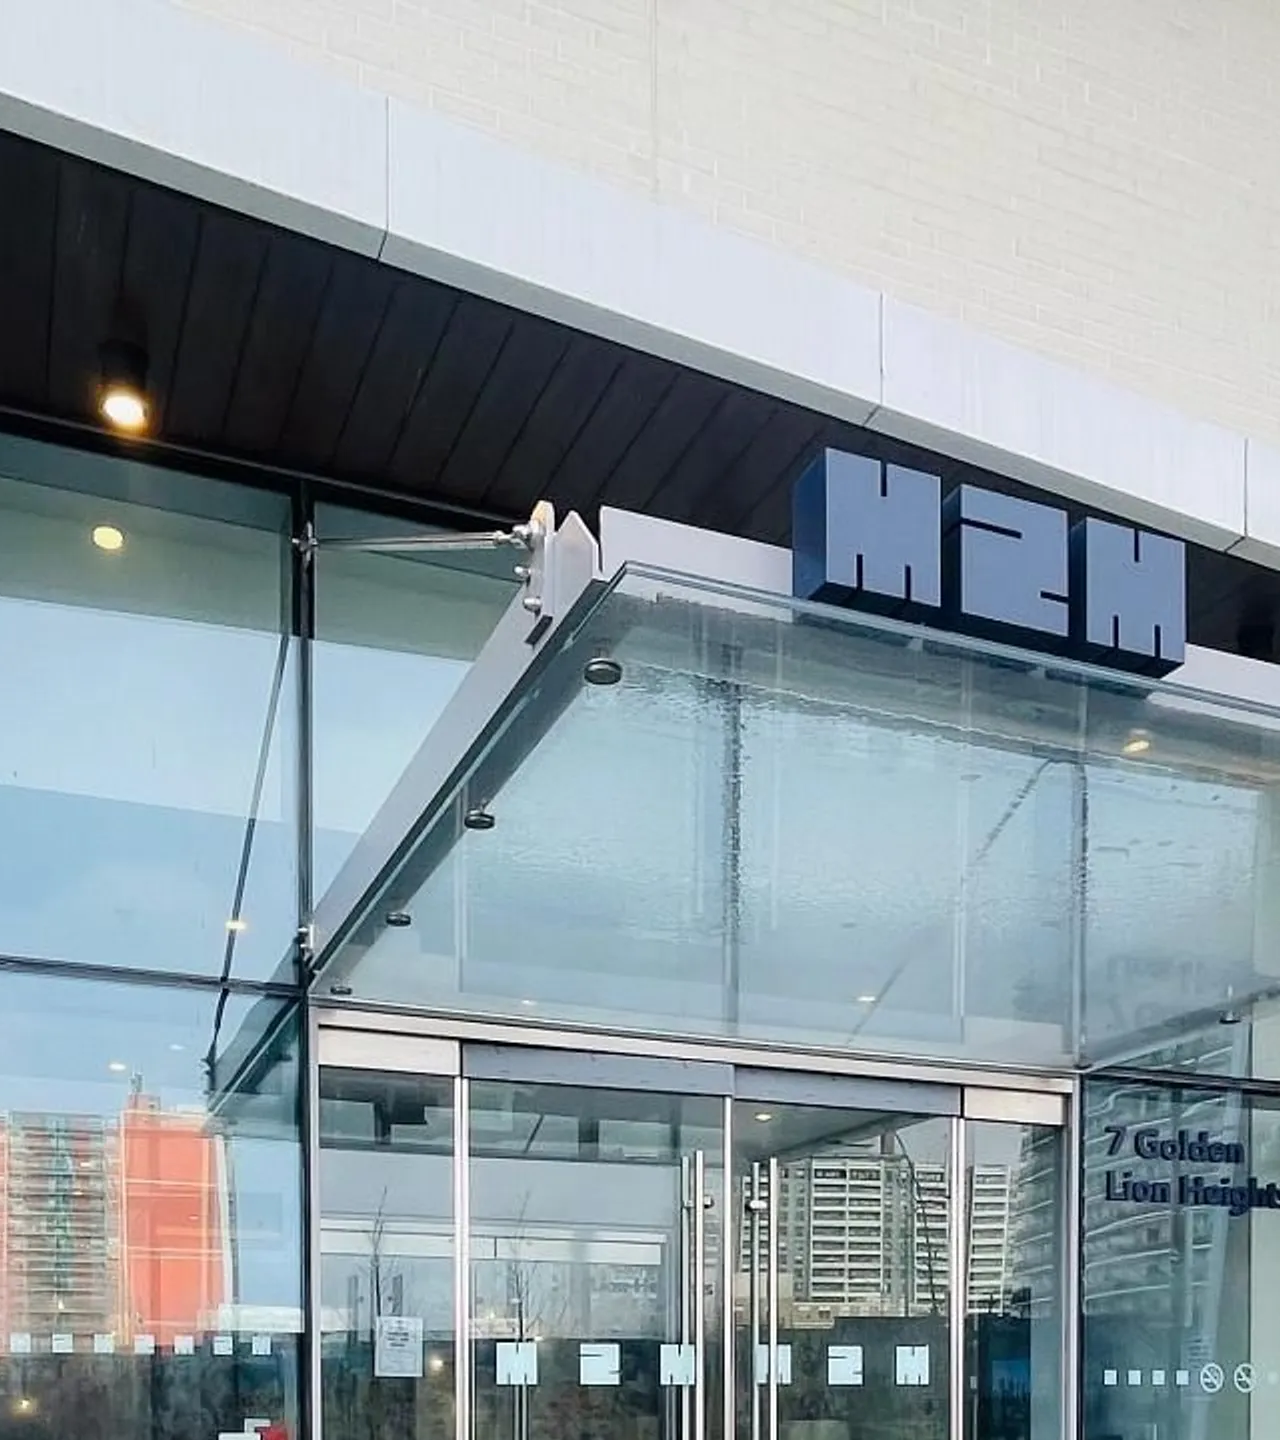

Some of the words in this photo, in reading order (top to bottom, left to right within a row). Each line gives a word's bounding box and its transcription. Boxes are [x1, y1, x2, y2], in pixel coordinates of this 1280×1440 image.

[1104, 1126, 1127, 1156] 7
[1134, 1128, 1245, 1163] Golden
[1105, 1170, 1170, 1202] Lion
